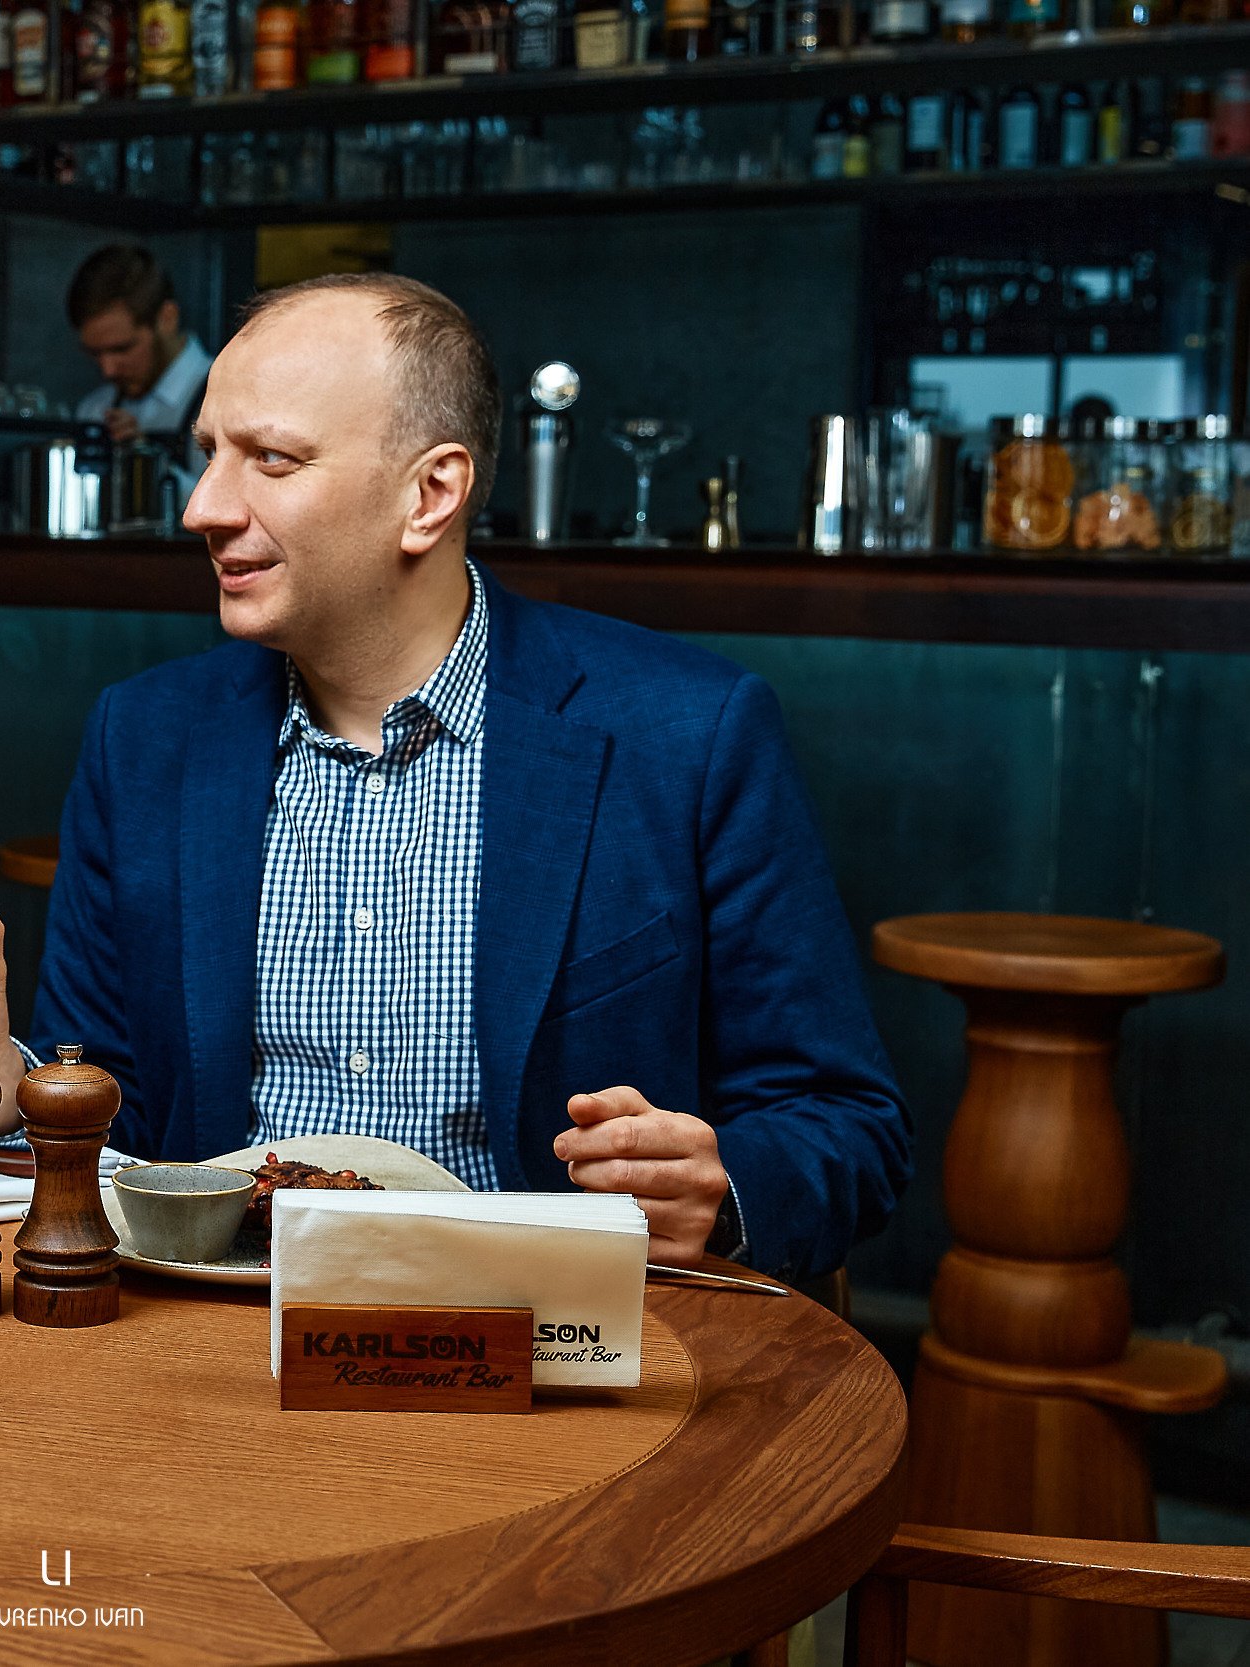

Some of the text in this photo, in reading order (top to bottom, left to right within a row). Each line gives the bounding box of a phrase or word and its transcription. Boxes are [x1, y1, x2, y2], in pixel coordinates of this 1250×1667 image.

[303, 1332, 486, 1360] KARLSON
[590, 1346, 622, 1362] Bar
[334, 1360, 514, 1388] Restaurant Bar
